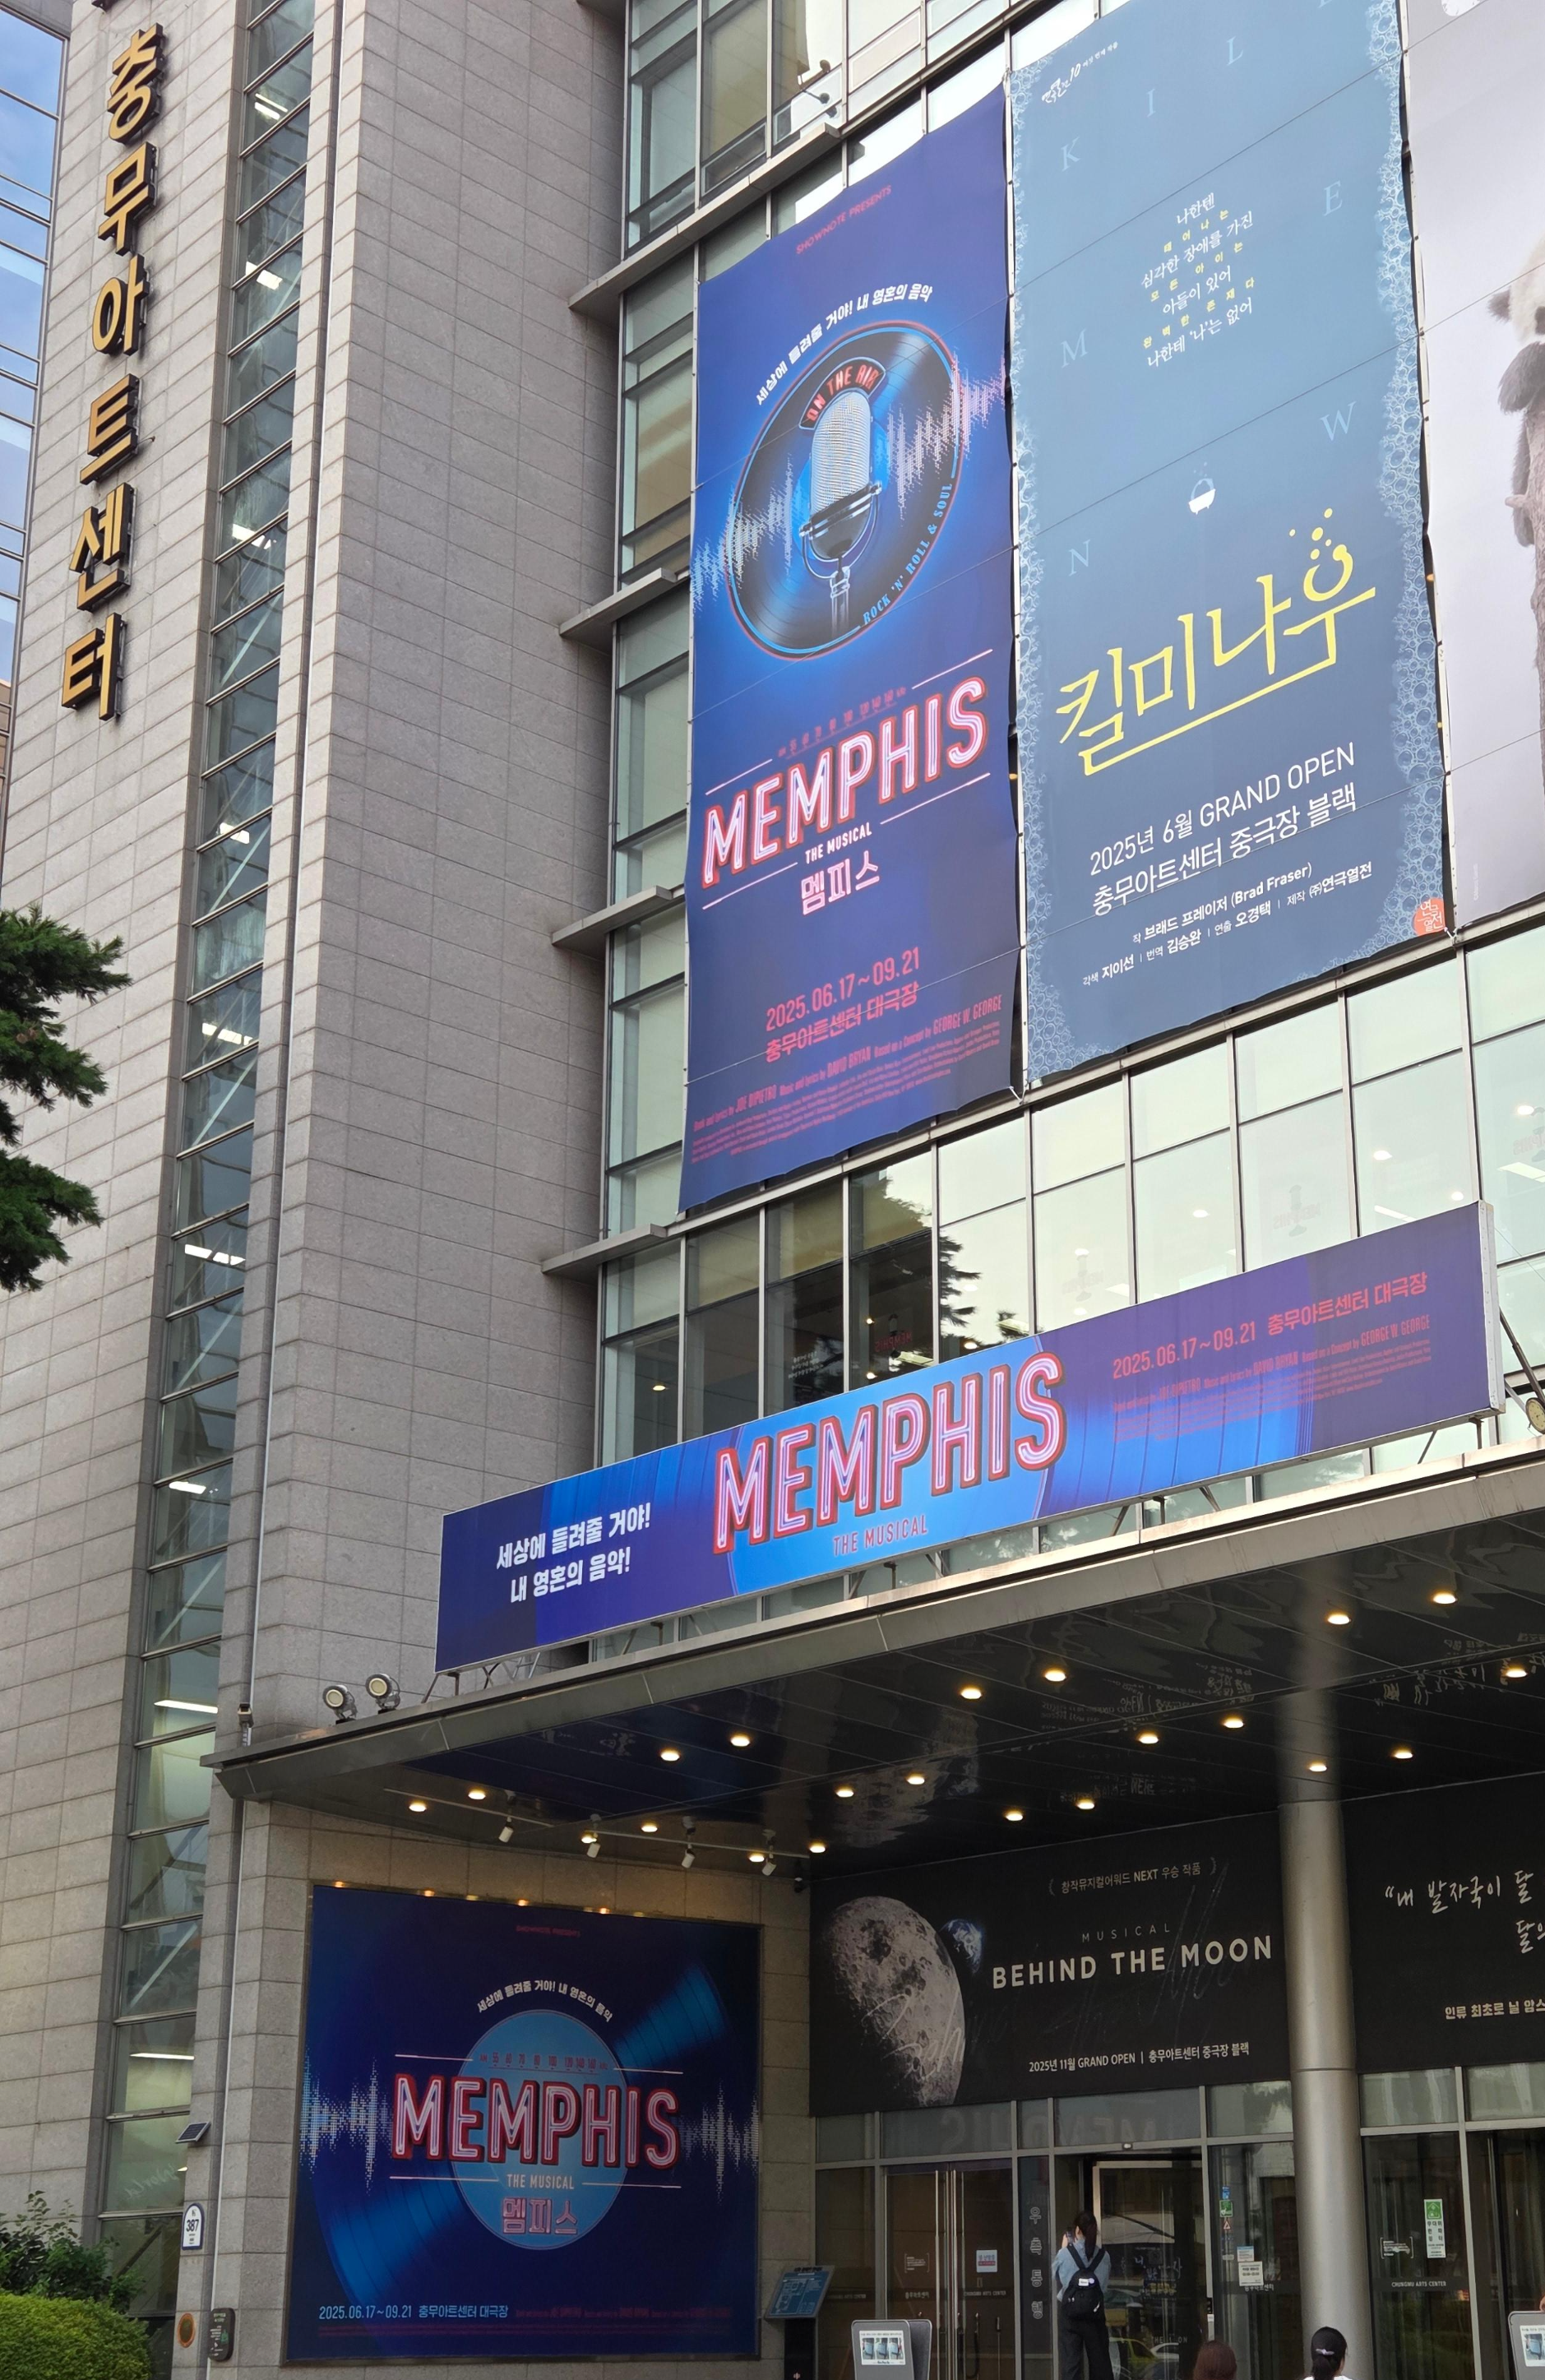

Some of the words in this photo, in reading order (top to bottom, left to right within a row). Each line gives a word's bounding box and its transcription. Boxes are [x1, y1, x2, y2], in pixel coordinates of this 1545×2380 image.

[1060, 137, 1081, 172] K
[796, 211, 847, 255] SHOWNOTE
[849, 185, 891, 218] PRESENTS
[1177, 192, 1215, 225] 나한텐
[1323, 181, 1344, 216] E
[1141, 255, 1180, 289] 심각한
[1183, 229, 1223, 262] 장애를
[1227, 211, 1254, 238] 가진
[1163, 282, 1201, 315] 아들이
[1205, 265, 1232, 294] 있어
[756, 360, 788, 405] 세상에
[789, 323, 823, 364] 들려줄
[826, 300, 853, 330] 거야!
[857, 294, 869, 311] 내
[872, 284, 908, 305] 영혼의
[908, 283, 933, 302] 음악
[1147, 334, 1186, 367] 나한테
[1226, 297, 1252, 326] 없어
[62, 22, 164, 720] 충무아트센터
[806, 396, 826, 421] ON
[826, 366, 853, 392] THE
[855, 363, 881, 391] AIR
[1321, 402, 1357, 442] W
[863, 593, 892, 626] ROCK
[905, 539, 931, 576] ROLL
[927, 522, 938, 535] &
[933, 483, 953, 519] SOUL
[1055, 544, 1376, 776] 킬미나우
[701, 675, 988, 891] MEMPHIS
[1090, 825, 1154, 876] 2025년
[1162, 809, 1193, 845] 6월
[1199, 774, 1281, 828] GRAND
[1288, 742, 1355, 790] OPEN
[804, 842, 825, 865] THE
[826, 822, 873, 859] MUSICAL
[1092, 836, 1223, 916] 충무아트센터
[1229, 805, 1301, 859] 중극장
[1307, 782, 1357, 828] 블랙
[799, 849, 881, 917] 멤피스
[1132, 932, 1142, 944] 작
[1144, 916, 1179, 940] 브래드
[1181, 895, 1228, 927] 프레이저
[1231, 881, 1264, 908] (Brad
[1266, 862, 1312, 891] Fraser)
[1102, 953, 1135, 979] 지이선
[1167, 928, 1202, 954] 김승완
[1235, 900, 1271, 927] 오경택
[766, 1002, 863, 1063] 충무아트센터
[867, 981, 919, 1021] 대극장
[933, 1011, 961, 1035] GEORGE
[973, 993, 1003, 1021] GEORGE
[1268, 1287, 1370, 1336] 충무아트센터
[1373, 1271, 1428, 1306] 대극장
[1361, 1325, 1390, 1347] GEORGE
[1400, 1314, 1430, 1336] GEORGE
[713, 1351, 1066, 1555] MEMPHIS
[496, 1533, 547, 1570] 세상에
[552, 1516, 604, 1555] 들려줄
[608, 1503, 651, 1538] 거야!
[833, 1534, 858, 1557] THE
[864, 1514, 928, 1550] MUSICAL
[511, 1575, 528, 1604] 내
[533, 1559, 584, 1598] 영혼의
[590, 1546, 631, 1582] 음악!
[1061, 1872, 1131, 1895] 창작뮤지컬어워드
[1133, 1868, 1159, 1882] NEXT
[1161, 1865, 1180, 1880] 우승
[1182, 1862, 1202, 1876] 작품
[1427, 1875, 1501, 1914] 발자국이
[1515, 1869, 1534, 1904] 달
[1082, 1922, 1173, 1943] MUSICAL
[992, 1956, 1097, 1990] BEHIND
[1111, 1949, 1166, 1974] THE
[1181, 1935, 1273, 1969] MOON
[477, 1989, 504, 2013] 세상에
[504, 1980, 533, 1998] 들려줄
[534, 1979, 557, 1992] 거야!
[558, 1982, 568, 1994] 내
[1445, 2006, 1467, 2020] 인류
[1470, 2003, 1505, 2018] 최초로
[1029, 2058, 1058, 2072] 2025년
[1059, 2058, 1076, 2072] 11월
[1077, 2054, 1109, 2069] GRAND
[1110, 2052, 1136, 2065] OPEN
[1148, 2046, 1200, 2063] 충무아트센터
[1201, 2044, 1229, 2059] 중극장
[1231, 2042, 1250, 2057] 블랙
[392, 2073, 681, 2169] MEMPHIS
[507, 2174, 526, 2188] THE
[530, 2174, 575, 2190] MUSICAL
[187, 2219, 200, 2233] 387
[502, 2197, 578, 2235] 멤피스
[418, 2304, 478, 2318] 충무아트센터
[479, 2304, 509, 2318] 대극장
